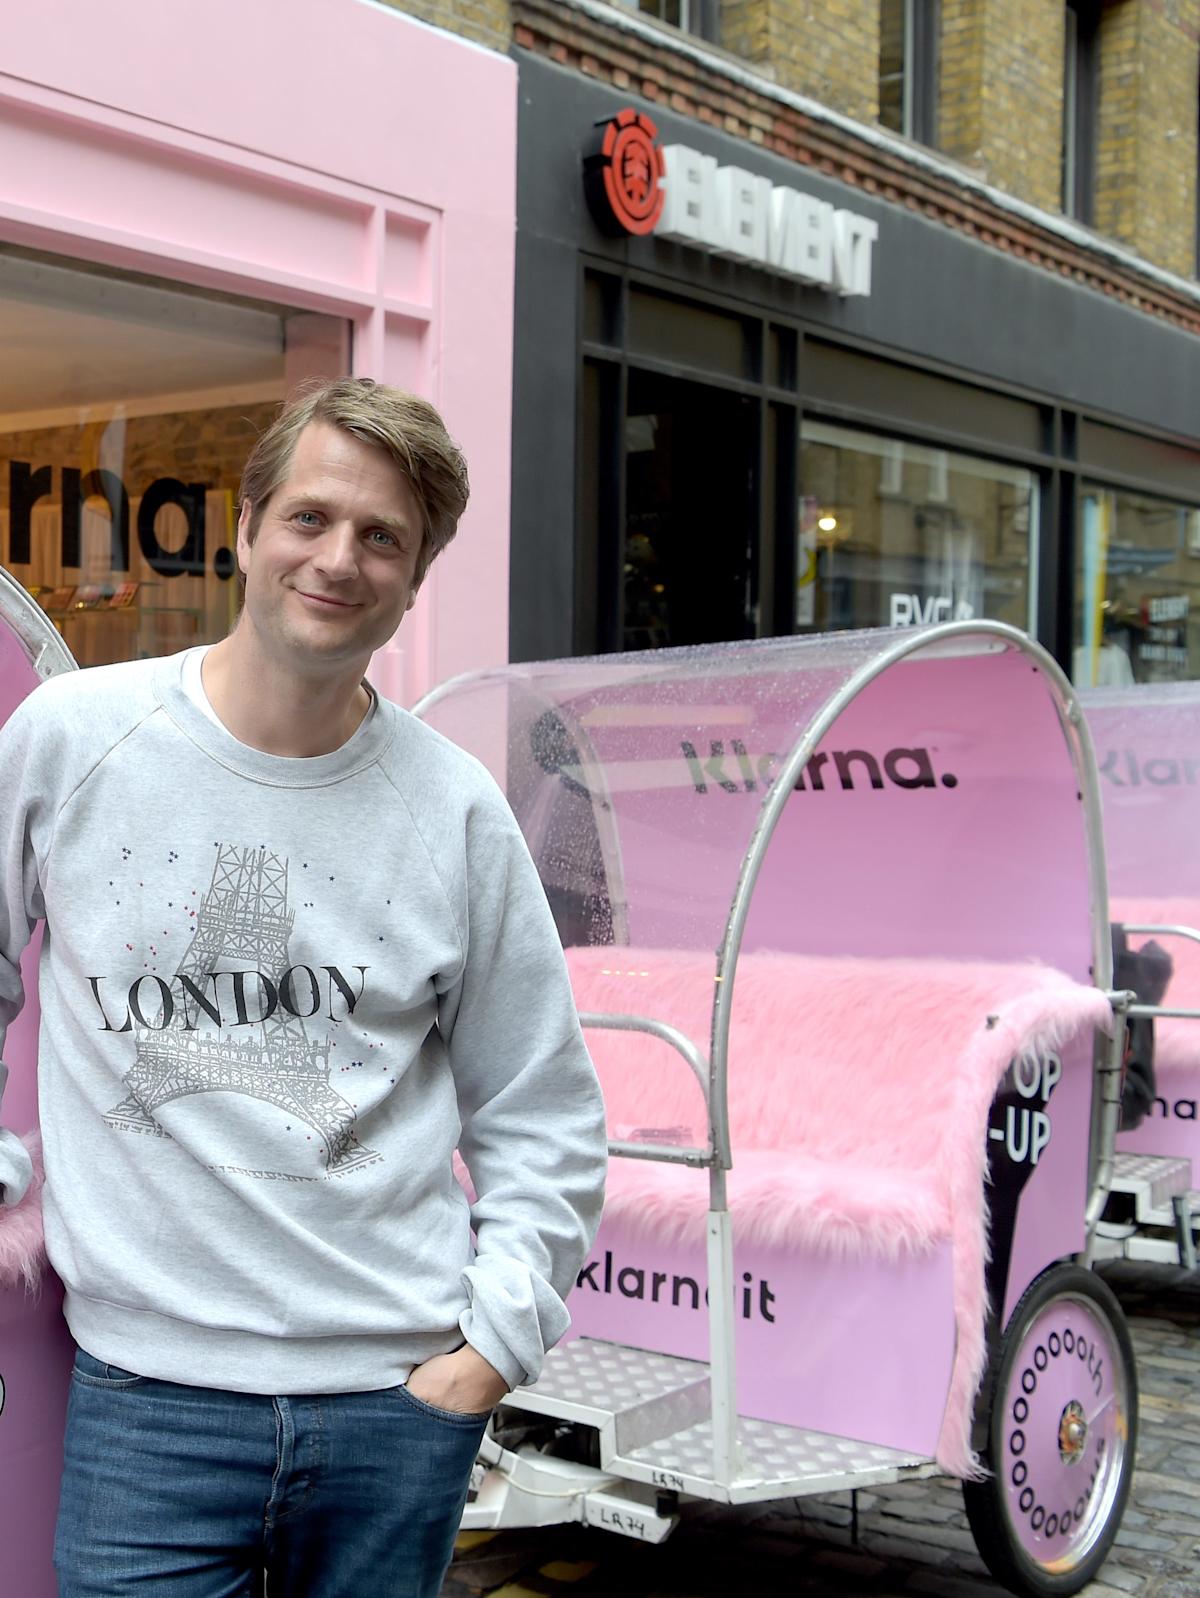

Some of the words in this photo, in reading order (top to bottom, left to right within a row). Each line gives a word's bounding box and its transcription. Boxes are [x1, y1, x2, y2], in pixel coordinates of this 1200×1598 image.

[657, 143, 879, 297] ELEMENT
[85, 964, 371, 1033] LONDON
[576, 1250, 736, 1310] klarn
[742, 1271, 775, 1323] it
